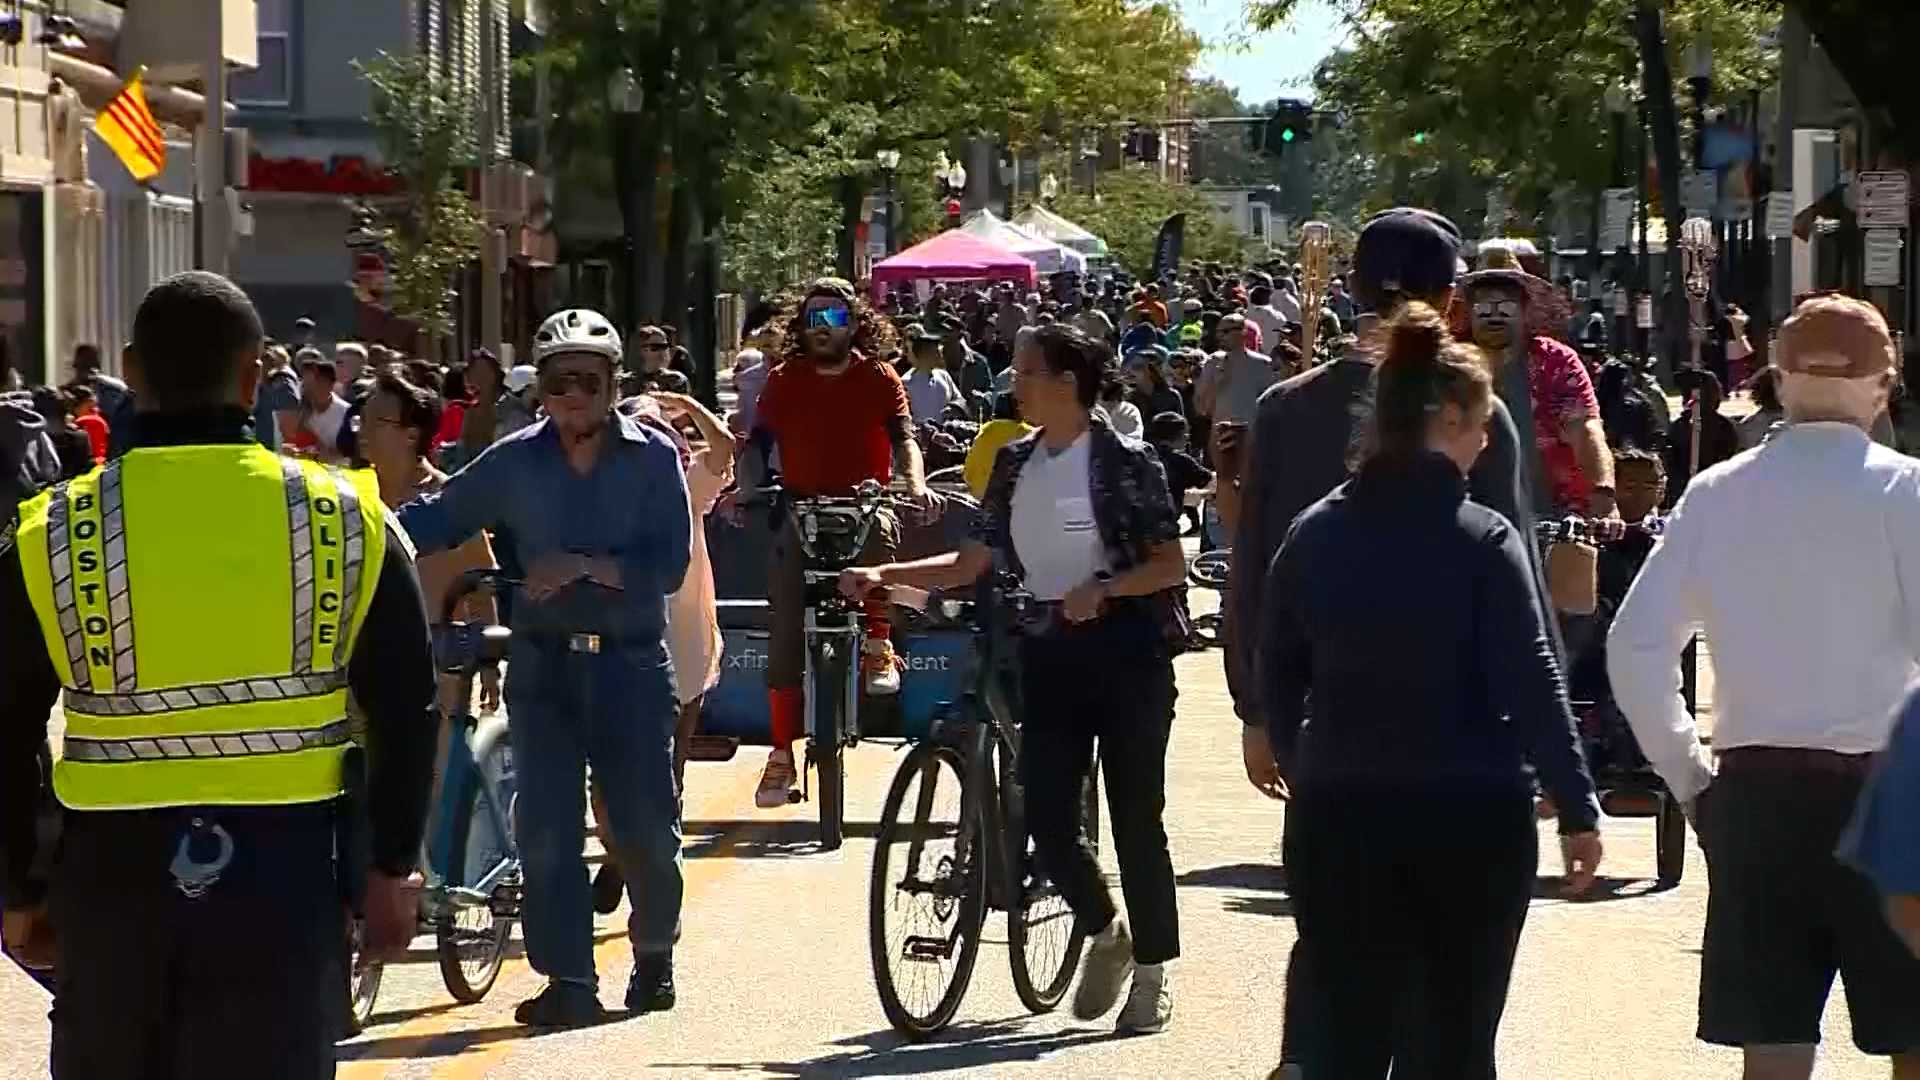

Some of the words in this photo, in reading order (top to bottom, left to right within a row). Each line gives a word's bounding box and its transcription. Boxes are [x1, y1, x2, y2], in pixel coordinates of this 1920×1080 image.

[74, 493, 111, 667] BOSTON
[314, 496, 339, 645] OLICE
[728, 648, 769, 668] xfin
[903, 651, 950, 670] dent
